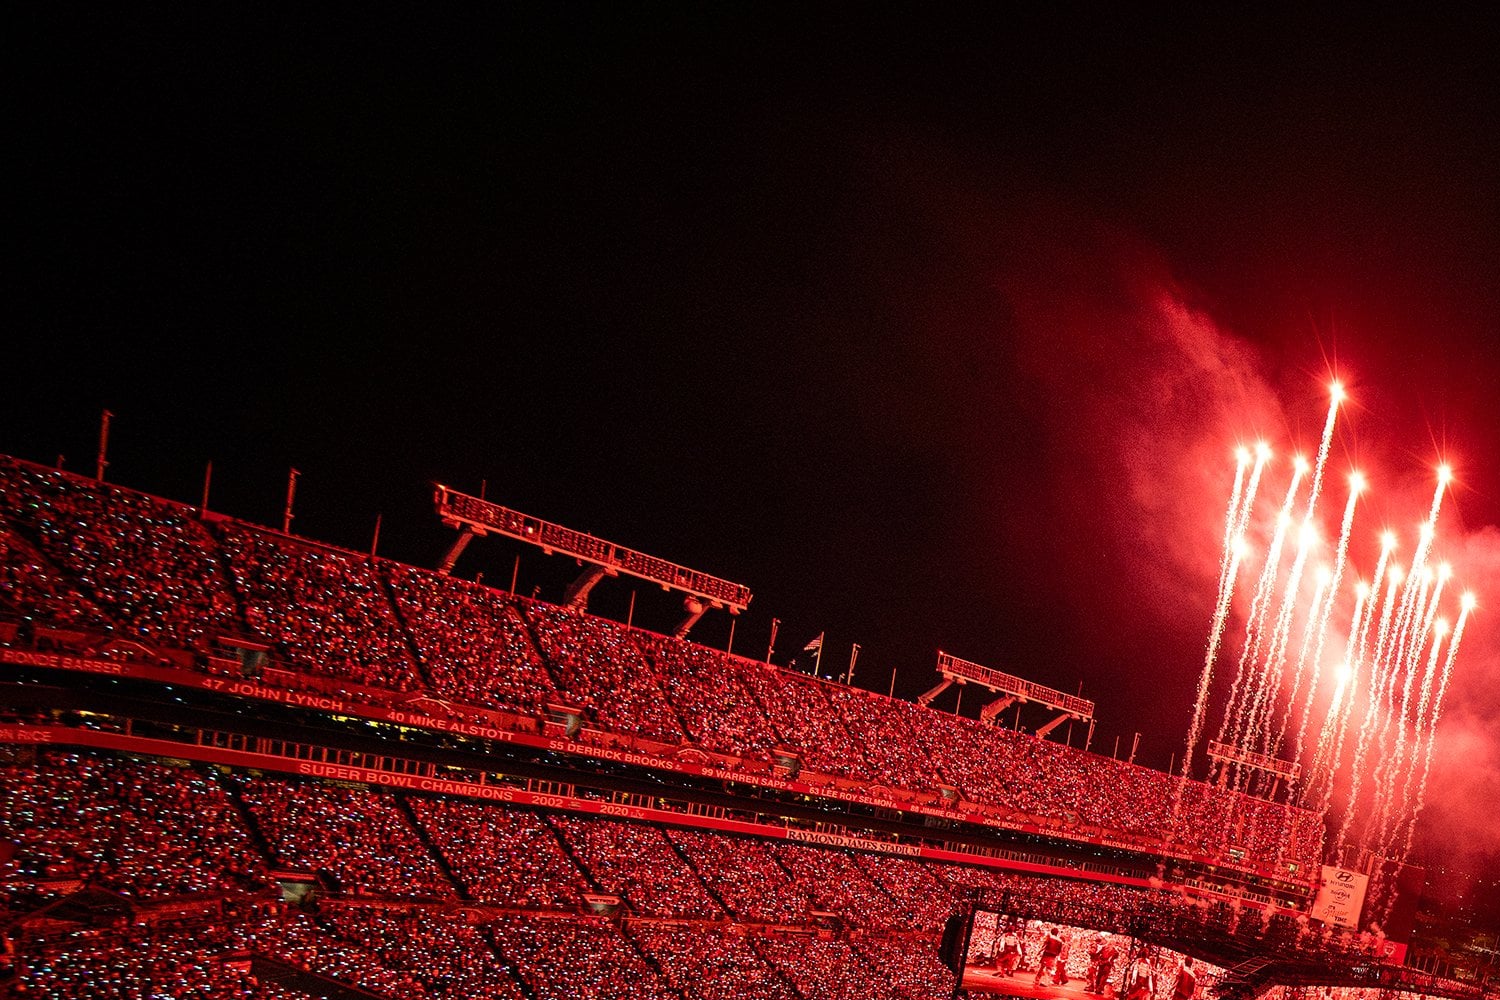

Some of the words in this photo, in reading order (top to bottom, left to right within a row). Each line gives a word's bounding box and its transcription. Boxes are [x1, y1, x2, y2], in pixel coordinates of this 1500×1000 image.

[2, 650, 59, 668] RONDE
[62, 656, 123, 675] BARBER
[202, 678, 225, 690] 47
[229, 684, 281, 700] JOHN
[286, 692, 343, 711] LYNCH
[387, 710, 405, 722] 40
[409, 714, 447, 730] MIKE
[450, 721, 515, 741] ALSTOTT
[549, 740, 564, 751] 55
[568, 743, 622, 761] DERRICK
[624, 753, 674, 770] BROOKS
[299, 763, 361, 782] SUPER
[365, 771, 417, 789] BOWL
[421, 778, 514, 801] CHAMPIONS
[531, 795, 564, 809] 2002
[600, 804, 629, 817] 2020
[701, 767, 714, 777] 99
[715, 769, 760, 785] WARREN
[761, 778, 787, 790] SAPP
[821, 789, 838, 798] LEE
[839, 792, 857, 802] ROY
[859, 795, 894, 808] SELMON
[945, 811, 967, 821] GILES
[982, 818, 1001, 827] JOHN
[788, 830, 844, 846] RAYMOND
[844, 838, 878, 851] JAMES
[879, 842, 921, 855] STADIUM
[1330, 880, 1356, 889] HYUNDAI
